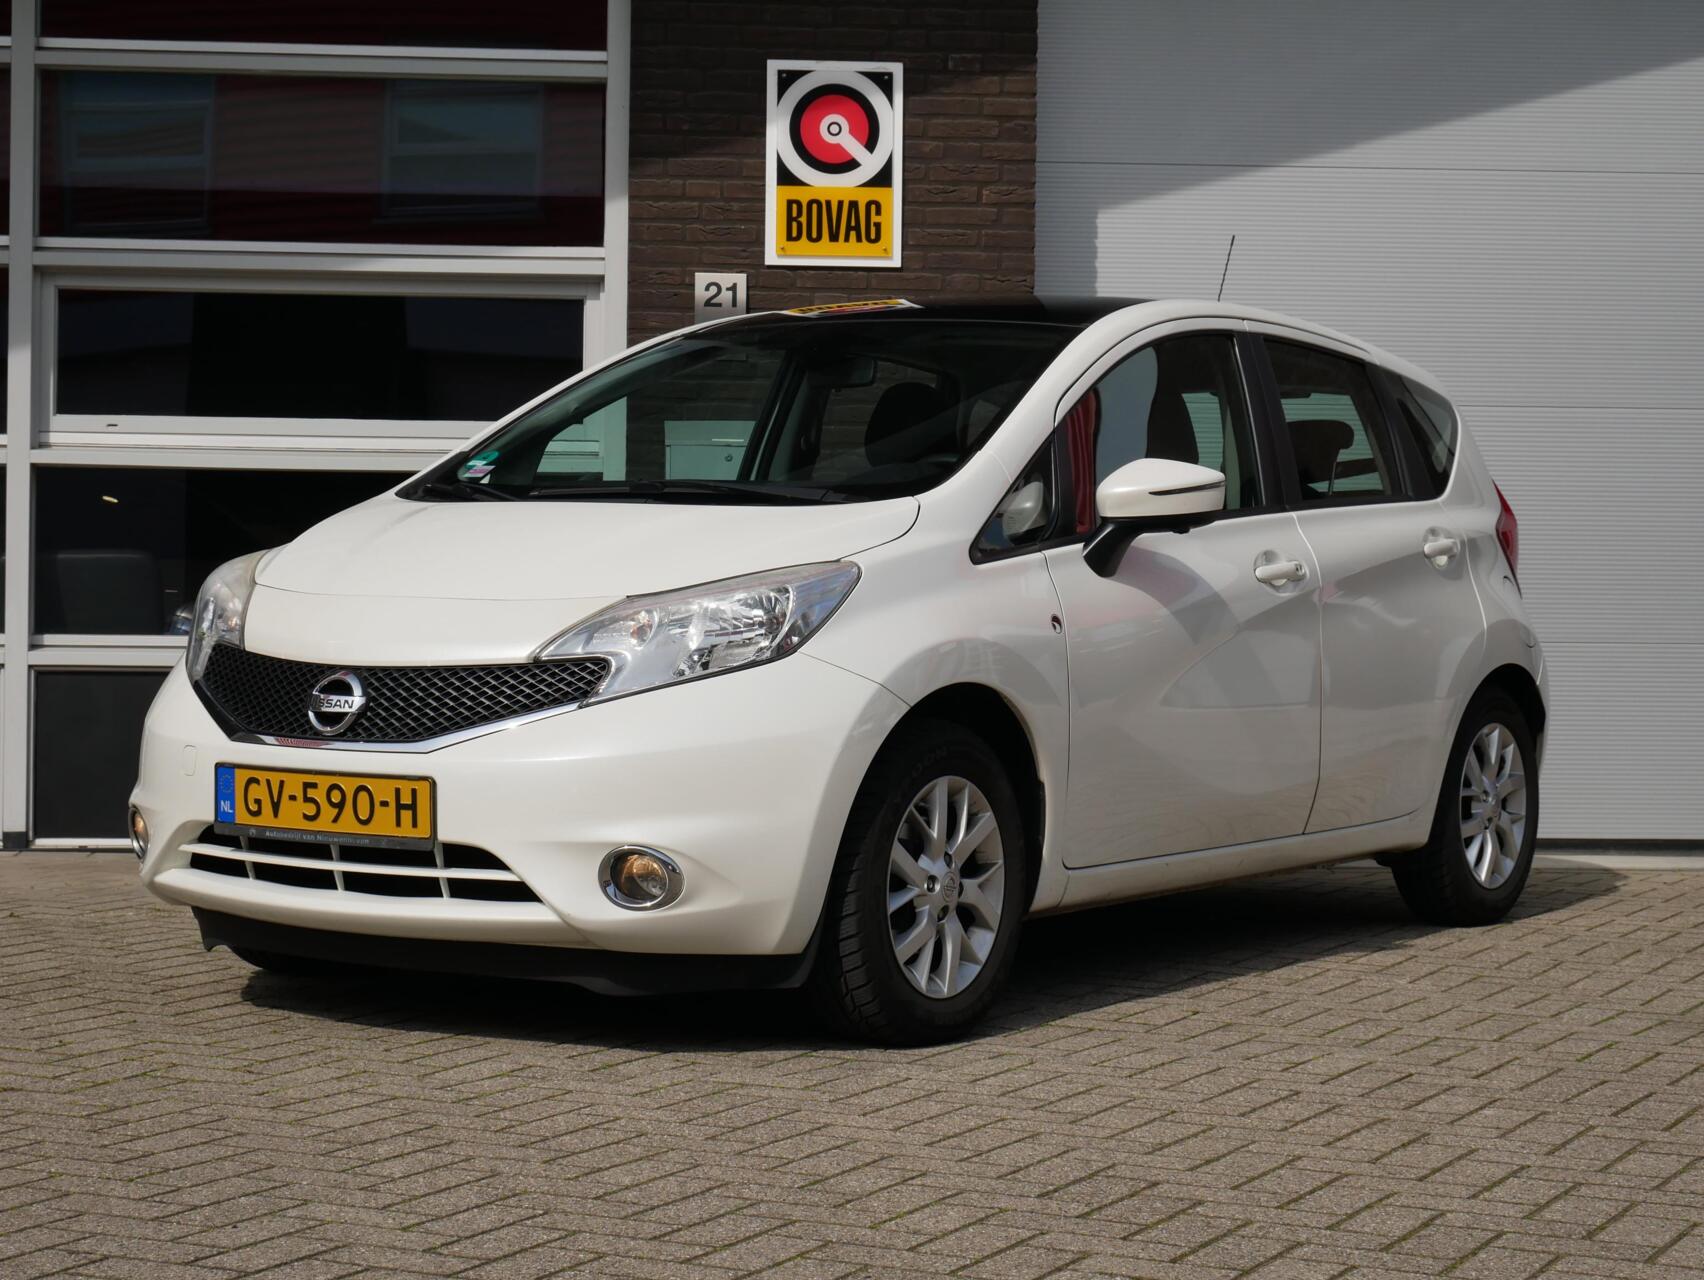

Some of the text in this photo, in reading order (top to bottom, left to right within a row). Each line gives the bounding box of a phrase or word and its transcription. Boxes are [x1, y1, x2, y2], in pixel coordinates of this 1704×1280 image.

[786, 199, 882, 244] BOVAG
[703, 282, 738, 308] 21
[311, 697, 354, 709] SSAN
[220, 800, 234, 813] NL
[243, 776, 418, 829] GV-590-H
[265, 830, 301, 841] Autobedrijf
[302, 833, 316, 841] van
